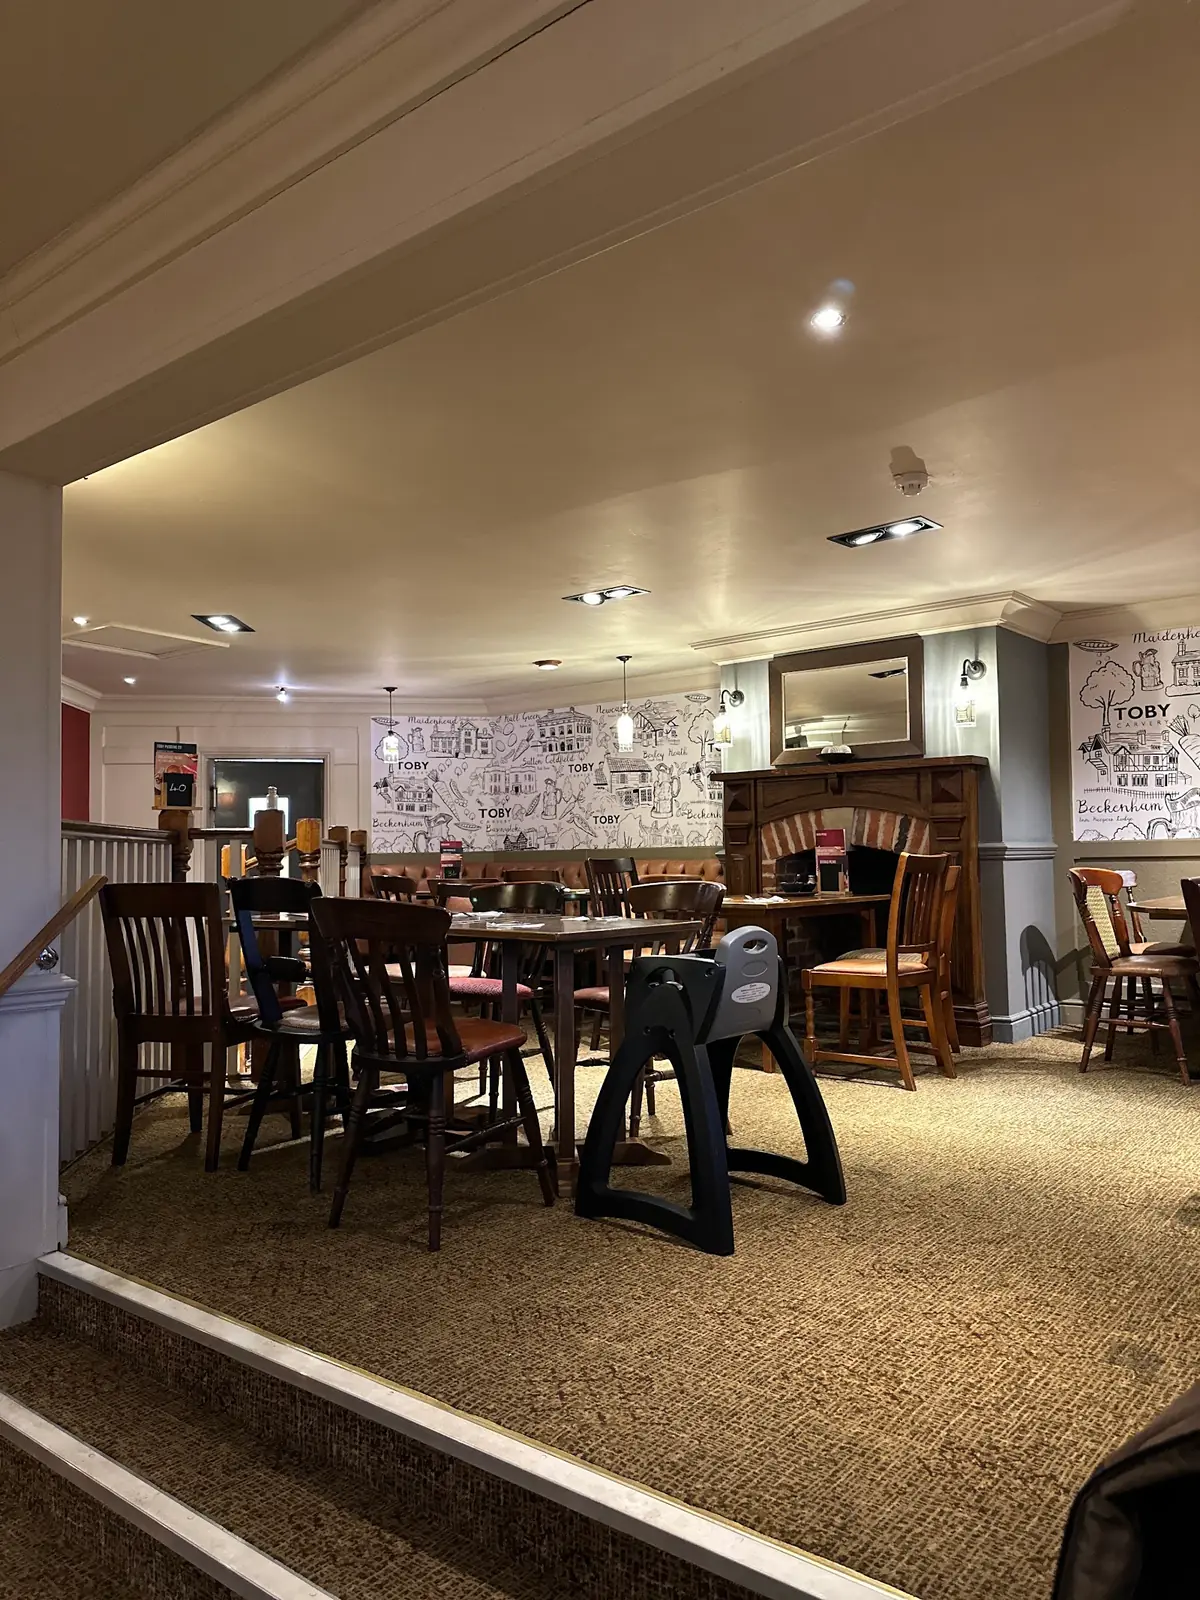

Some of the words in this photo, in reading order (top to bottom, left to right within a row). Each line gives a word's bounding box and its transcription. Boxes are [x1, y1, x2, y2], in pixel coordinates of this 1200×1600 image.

[1113, 703, 1171, 720] TOBY
[1116, 719, 1169, 729] CARVERY
[398, 761, 430, 770] TOBY
[568, 762, 595, 774] TOBY
[1077, 798, 1163, 814] Beckenham
[478, 807, 512, 819] TOBY
[372, 817, 424, 828] Beckenham
[593, 814, 621, 825] TOBY
